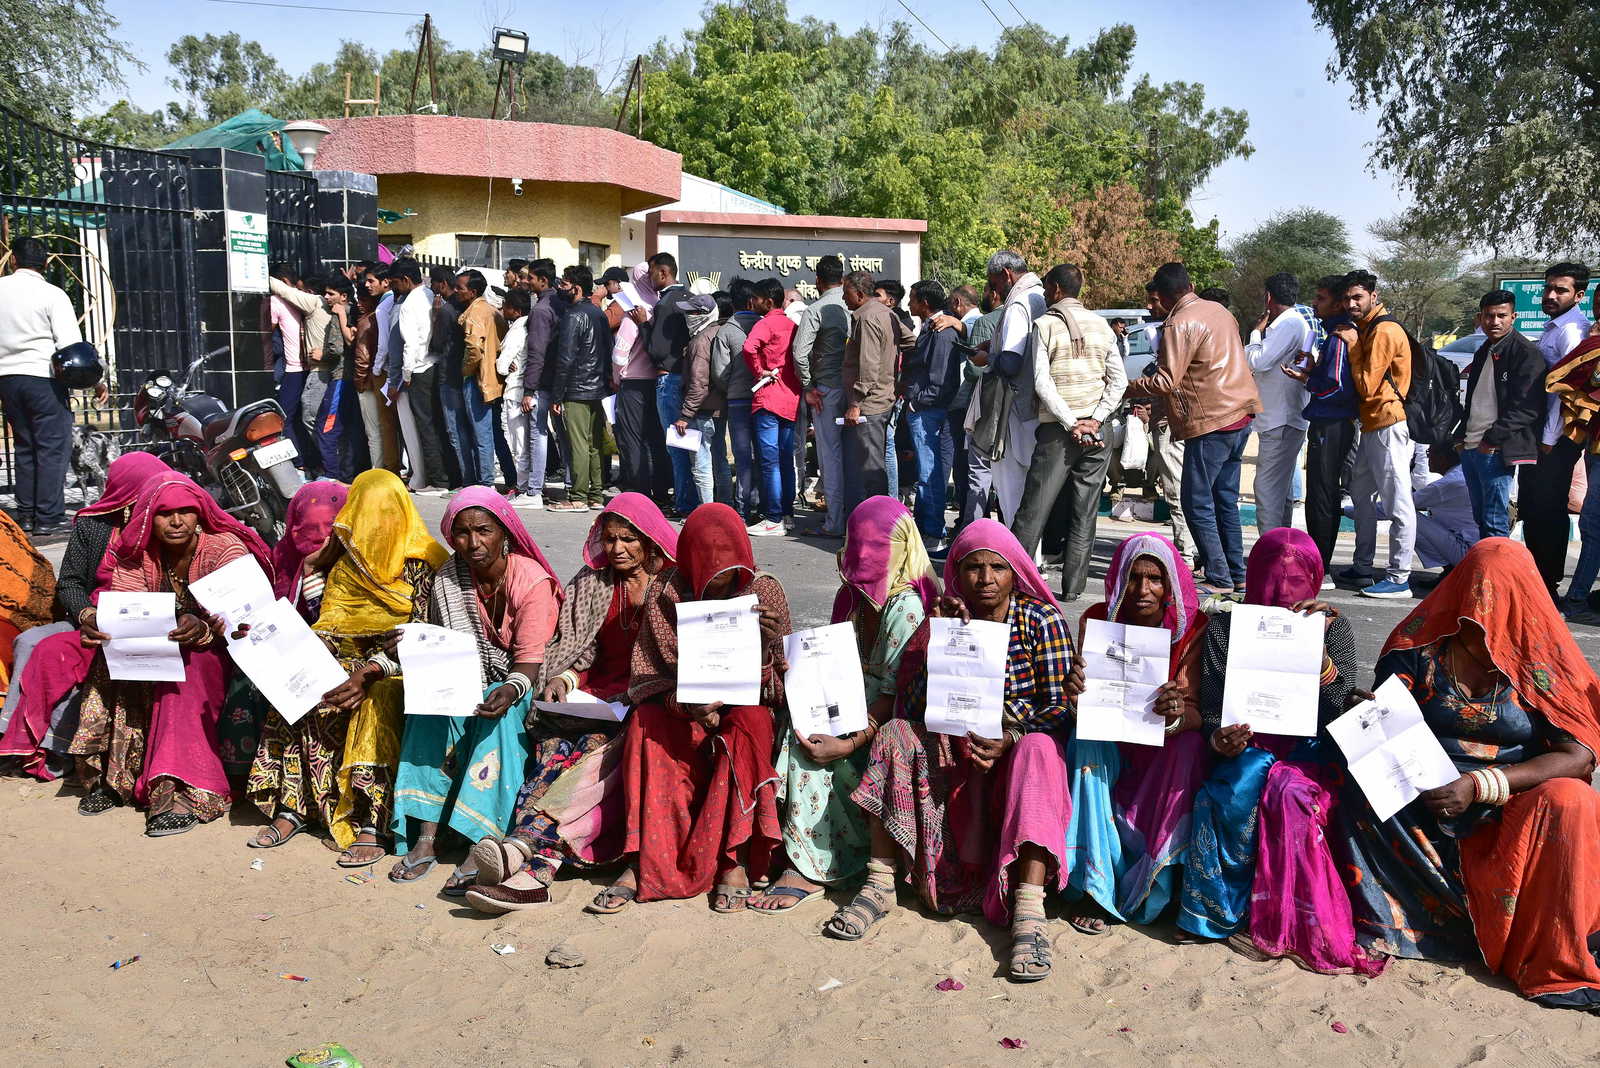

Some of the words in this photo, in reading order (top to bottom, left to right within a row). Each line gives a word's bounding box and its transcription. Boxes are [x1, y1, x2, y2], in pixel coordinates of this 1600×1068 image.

[739, 250, 773, 271] केन्द्रीय
[776, 254, 802, 277] शुष्क
[849, 255, 884, 272] संस्थान
